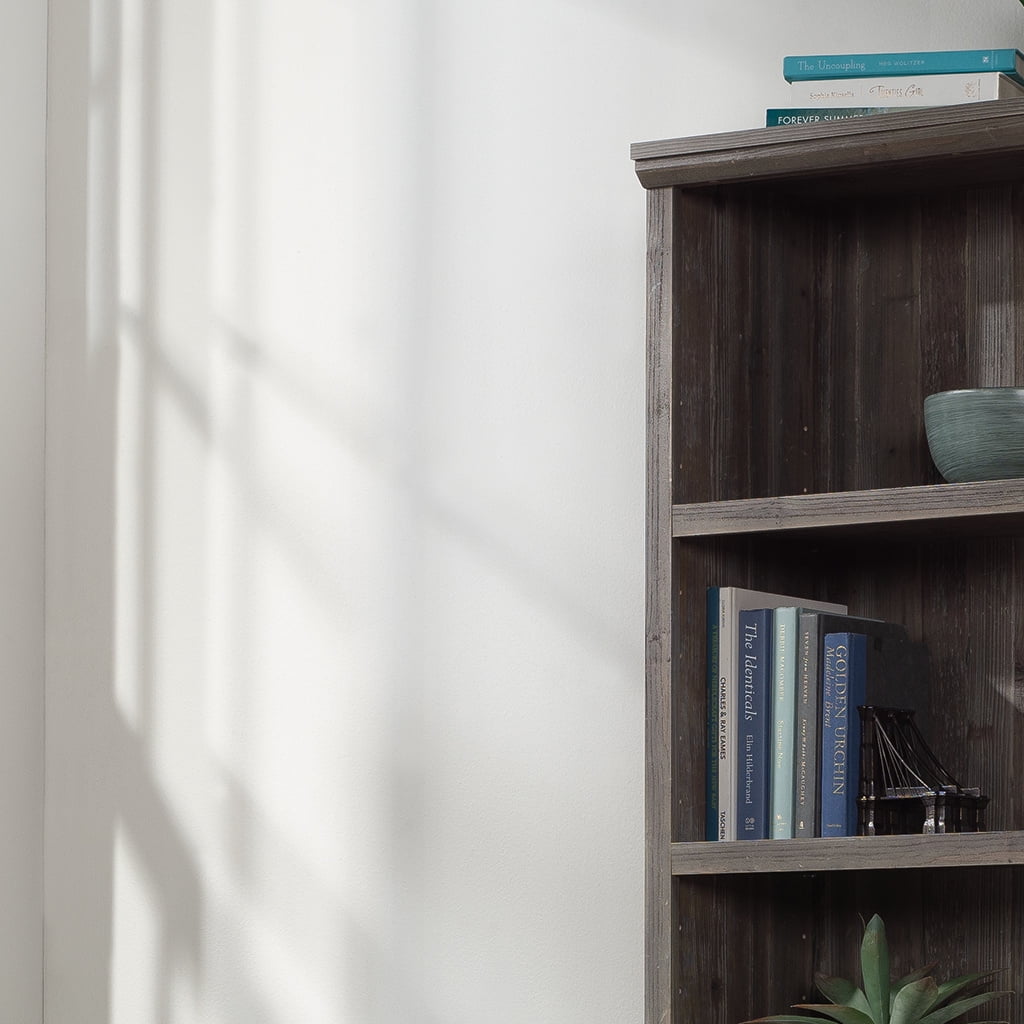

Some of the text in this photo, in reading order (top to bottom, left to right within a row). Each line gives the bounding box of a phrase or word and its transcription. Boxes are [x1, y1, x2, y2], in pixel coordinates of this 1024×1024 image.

[797, 59, 866, 71] The Uncoupling
[778, 115, 820, 125] FOREVER
[744, 623, 758, 721] The Identicals
[825, 701, 834, 728] Brent
[832, 645, 848, 796] GOLDEN URCHIN
[745, 734, 754, 804] Elin Hilderbrand
